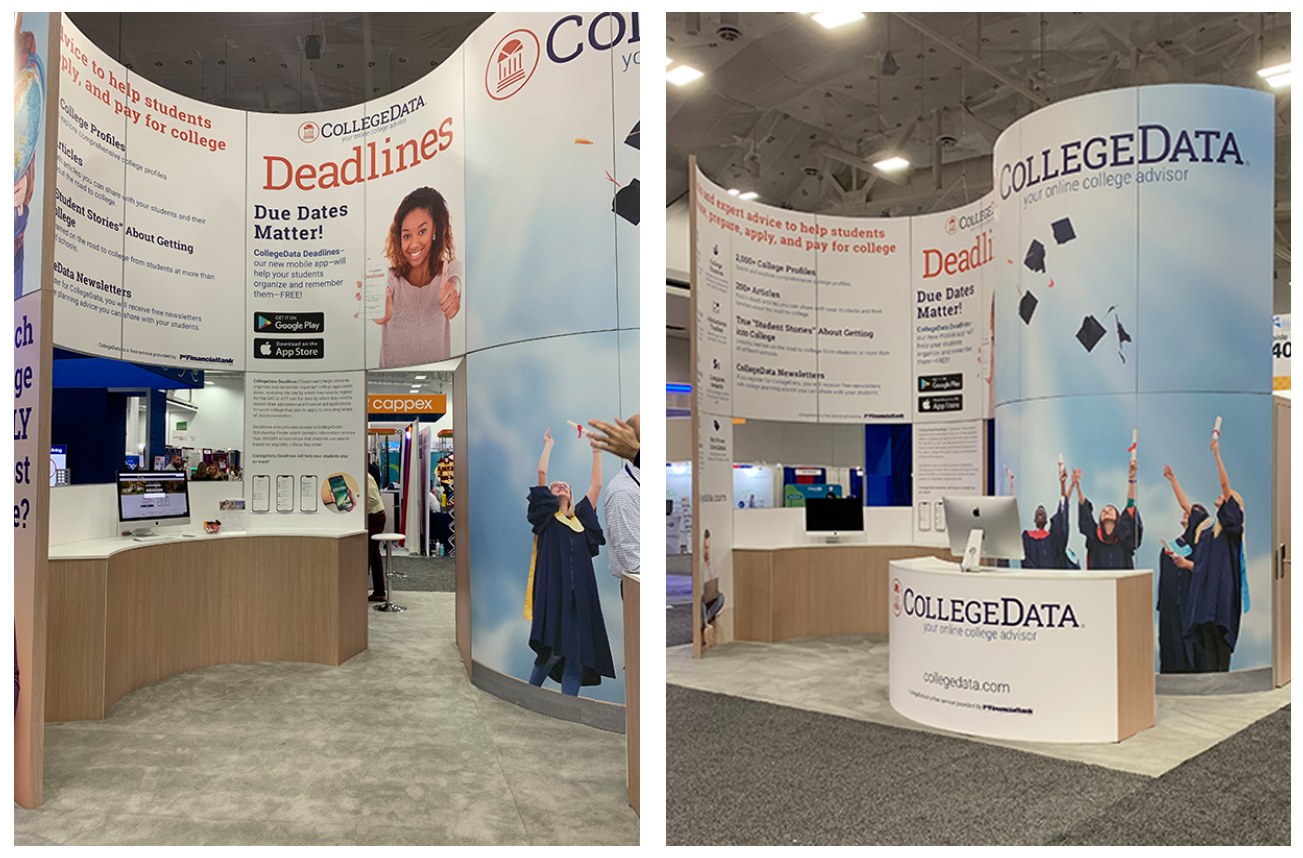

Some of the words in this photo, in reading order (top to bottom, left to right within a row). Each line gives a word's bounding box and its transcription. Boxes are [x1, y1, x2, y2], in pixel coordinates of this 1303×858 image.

[91, 60, 105, 80] to
[108, 70, 141, 103] help
[144, 96, 213, 129] students
[85, 79, 111, 106] and
[114, 100, 142, 124] pay
[145, 114, 167, 134] for
[170, 128, 227, 152] college
[320, 95, 426, 139] COLLEGEDATA
[59, 98, 89, 130] College
[90, 123, 126, 152] Profiles
[79, 131, 121, 161] comprehensive
[262, 116, 454, 191] Deadlines
[999, 124, 1244, 201] COLLEGEDATA
[1023, 189, 1043, 210] your
[1045, 180, 1080, 199] online
[1082, 169, 1132, 191] college
[1136, 166, 1190, 184] advisor
[105, 185, 121, 199] share
[122, 195, 136, 205] with
[150, 203, 178, 218] students
[253, 204, 291, 221] Due
[297, 204, 349, 221] Dates
[716, 197, 745, 219] expert
[746, 209, 783, 230] advice
[785, 220, 797, 232] to
[800, 221, 828, 238] help
[831, 226, 886, 239] students
[125, 226, 155, 244] About
[157, 235, 194, 255] Getting
[253, 224, 324, 241] Matter!
[744, 225, 777, 245] apply,
[779, 235, 803, 248] and
[806, 239, 829, 252] pay
[831, 240, 850, 253] for
[852, 242, 897, 256] college
[108, 248, 130, 263] college
[130, 255, 146, 267] from
[146, 260, 174, 274] students
[253, 249, 301, 259] CollegeData
[922, 228, 993, 279] Deadli
[286, 259, 313, 268] mobile
[756, 259, 785, 273] College
[785, 265, 817, 276] Profiles
[253, 269, 271, 279] help
[272, 271, 290, 280] your
[291, 269, 325, 278] students
[76, 271, 132, 299] Newsletters
[253, 281, 287, 290] organize
[288, 280, 304, 289] and
[305, 279, 344, 289] remember
[752, 286, 781, 299] Articles
[917, 290, 943, 303] Due
[945, 285, 975, 300] Dates
[128, 303, 151, 315] receive
[164, 310, 203, 323] newsletters
[917, 302, 963, 319] Matter!
[141, 315, 155, 325] with
[171, 319, 201, 331] students.
[274, 321, 303, 331] Google
[304, 320, 321, 331] Play
[749, 330, 776, 342] College
[817, 327, 843, 337] About
[843, 328, 874, 339] Getting
[275, 347, 295, 358] App
[296, 347, 319, 356] Store
[735, 363, 776, 376] CollegeData
[777, 368, 825, 380] Newsletters
[372, 399, 433, 412] cappex
[932, 402, 945, 411] App
[903, 588, 1079, 628] COLLEGEDATA
[939, 625, 963, 637] online
[964, 626, 998, 642] college
[1000, 629, 1037, 642] advisor
[923, 671, 1011, 694] collegedata.com
